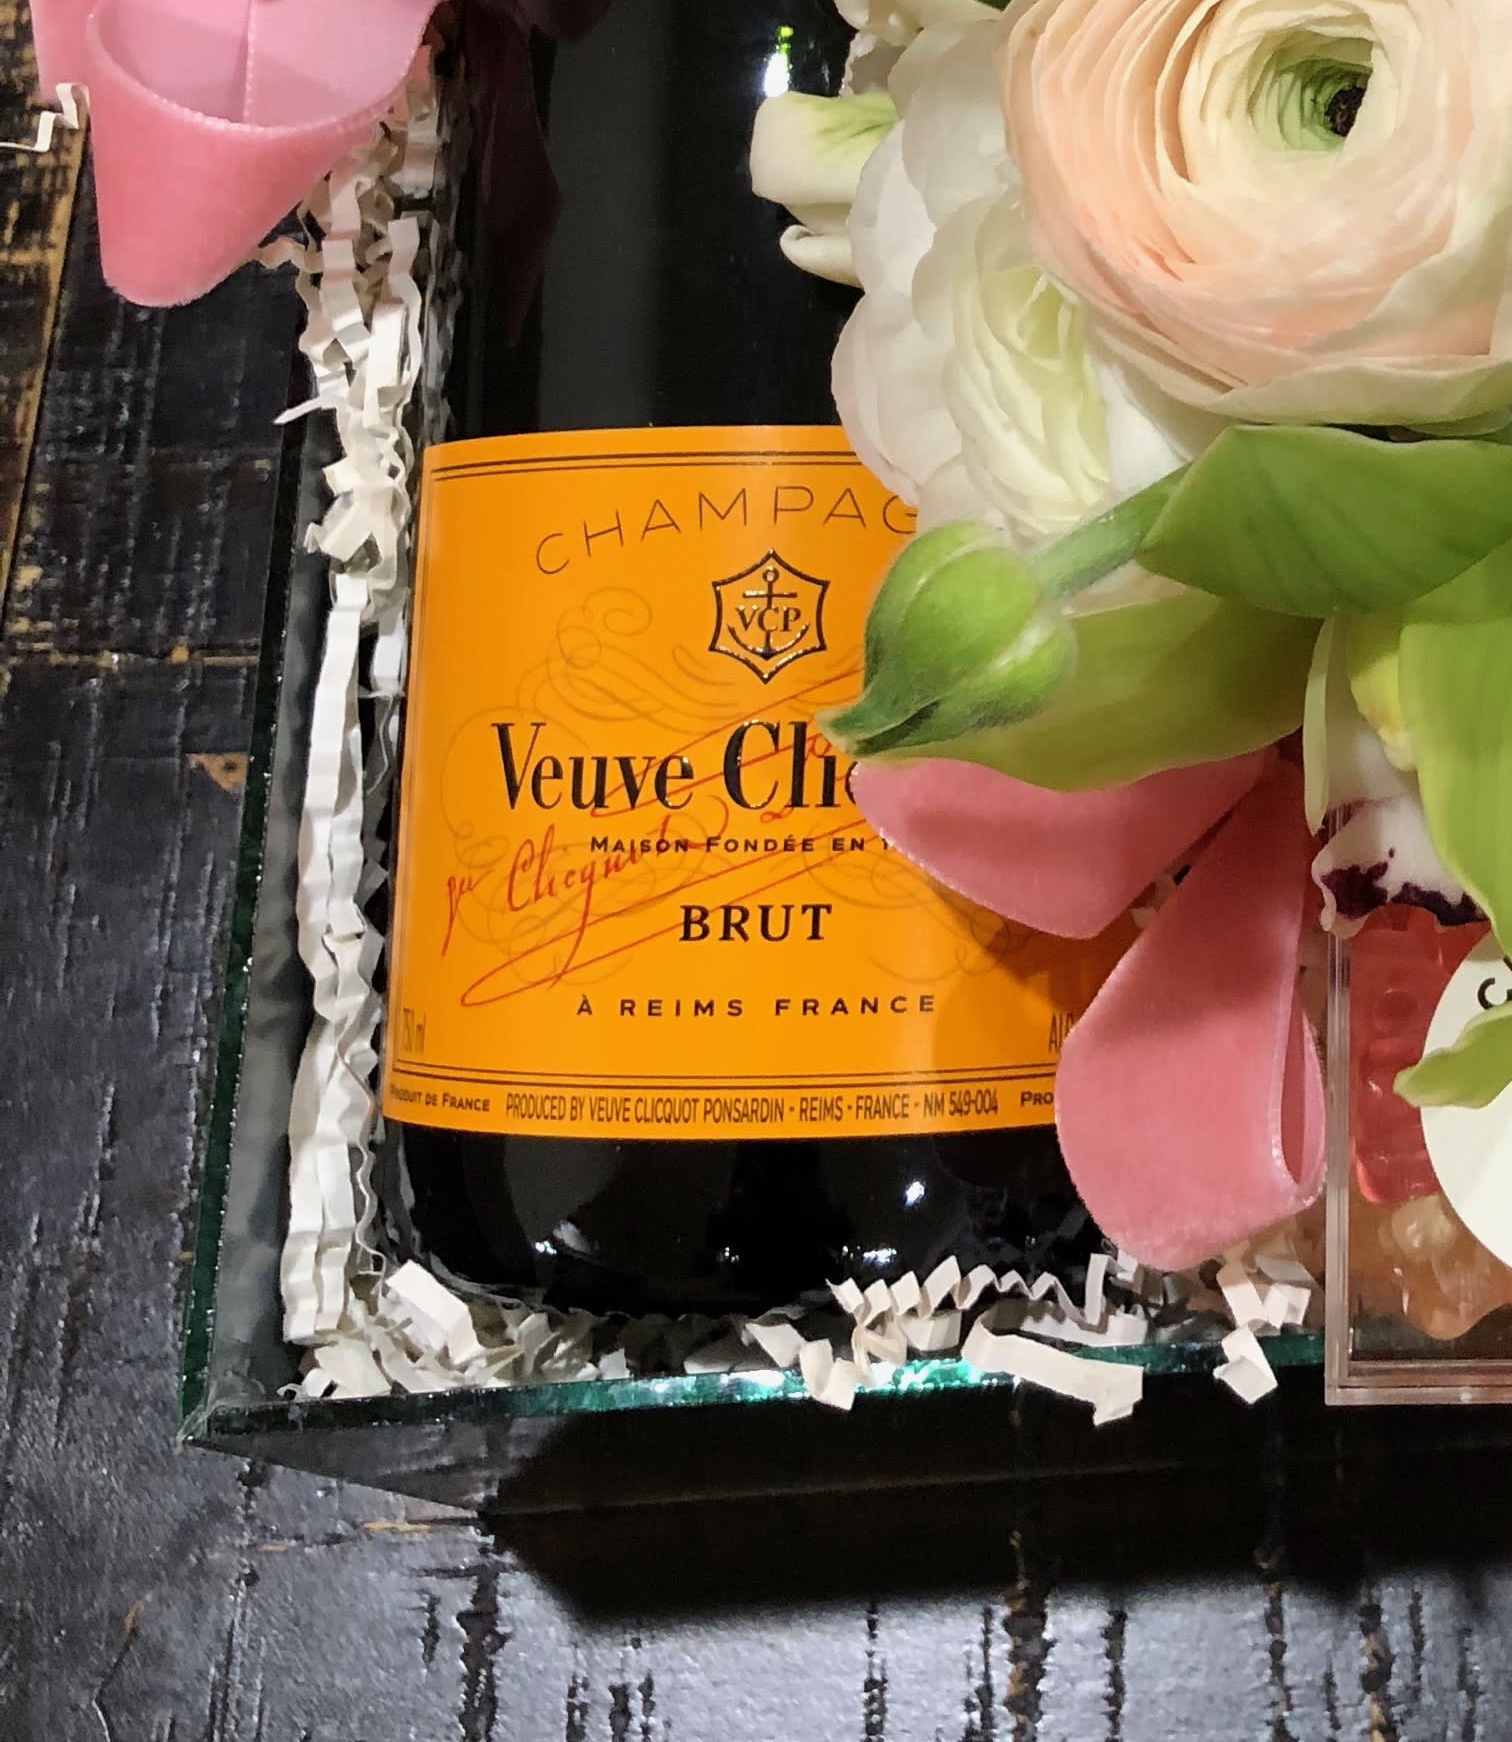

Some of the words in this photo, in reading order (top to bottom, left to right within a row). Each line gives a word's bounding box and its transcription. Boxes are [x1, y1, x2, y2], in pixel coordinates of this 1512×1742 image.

[735, 605, 802, 633] VCP
[490, 721, 696, 811] Veuve
[590, 835, 689, 853] MAISON
[705, 833, 816, 853] FONDÉE
[832, 837, 866, 852] EN
[679, 903, 833, 944] BRUT
[577, 994, 594, 1016] À
[619, 998, 744, 1018] REIMS
[774, 994, 936, 1017] FRANCE
[441, 1091, 491, 1113] FRANCE
[505, 1092, 567, 1122] PRODUCED
[570, 1094, 586, 1122] BY
[588, 1096, 631, 1123] VEUVE
[634, 1097, 700, 1125] CLICQUOT
[703, 1097, 785, 1124] PONSARDIN
[799, 1095, 844, 1123] REIMS
[855, 1093, 910, 1120] FRANCE
[923, 1092, 945, 1118] NM
[947, 1089, 999, 1116] 549-004
